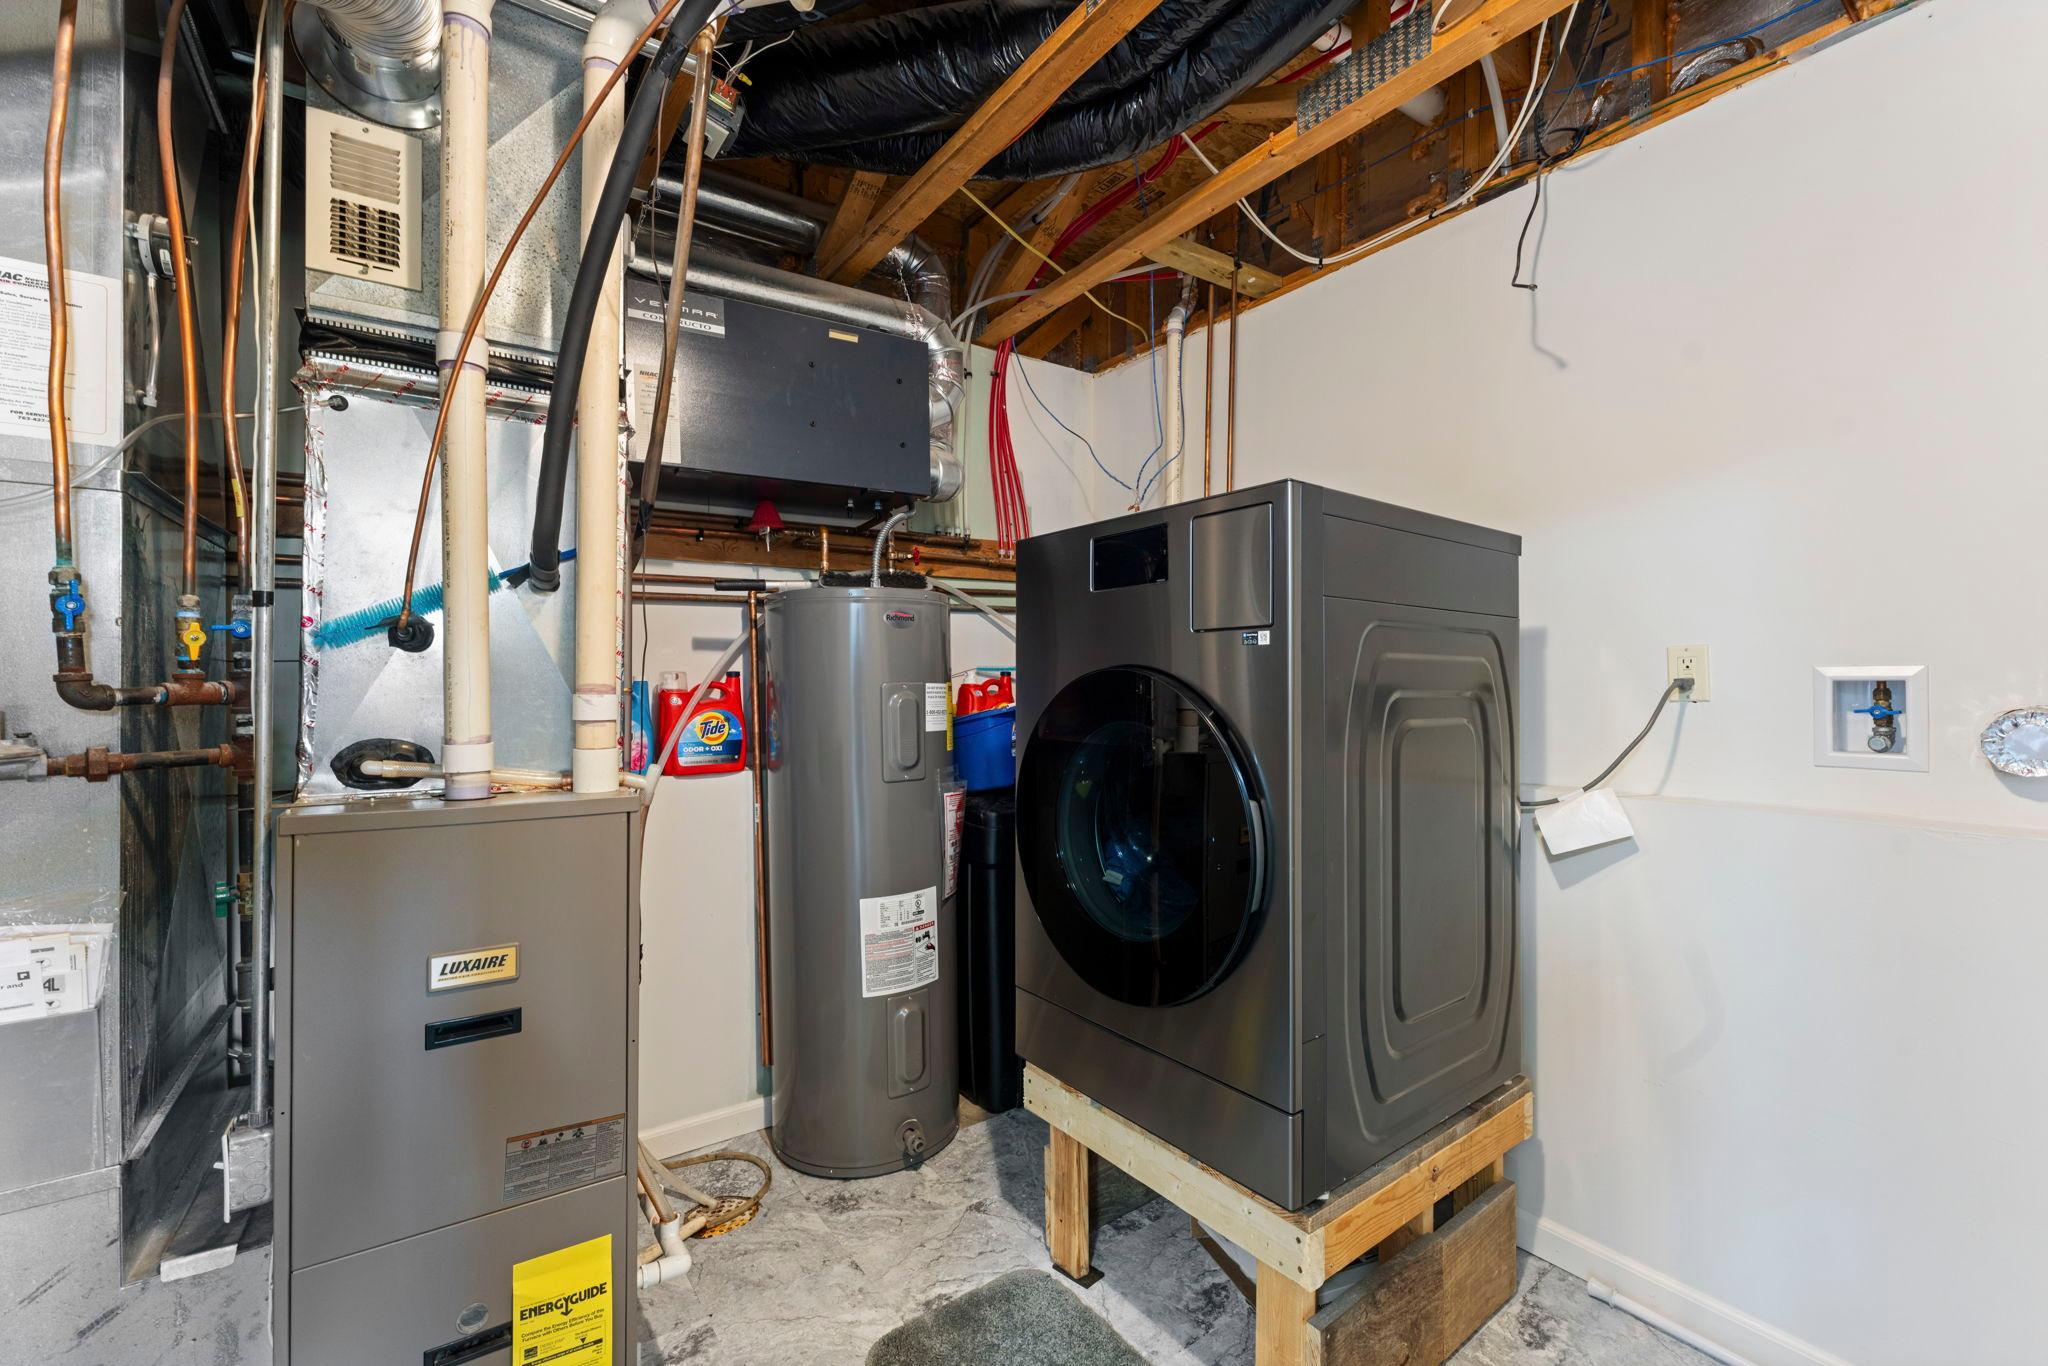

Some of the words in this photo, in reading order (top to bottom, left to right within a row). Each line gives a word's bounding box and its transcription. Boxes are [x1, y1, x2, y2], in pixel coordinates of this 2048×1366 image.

[26, 411, 50, 419] SERVIC
[700, 720, 726, 739] Tide
[440, 954, 508, 976] LUXAIRE
[520, 1282, 607, 1321] ENERGYGUIDE
[521, 1328, 543, 1340] Compare
[552, 1321, 568, 1331] Energy
[552, 1325, 569, 1334] Others
